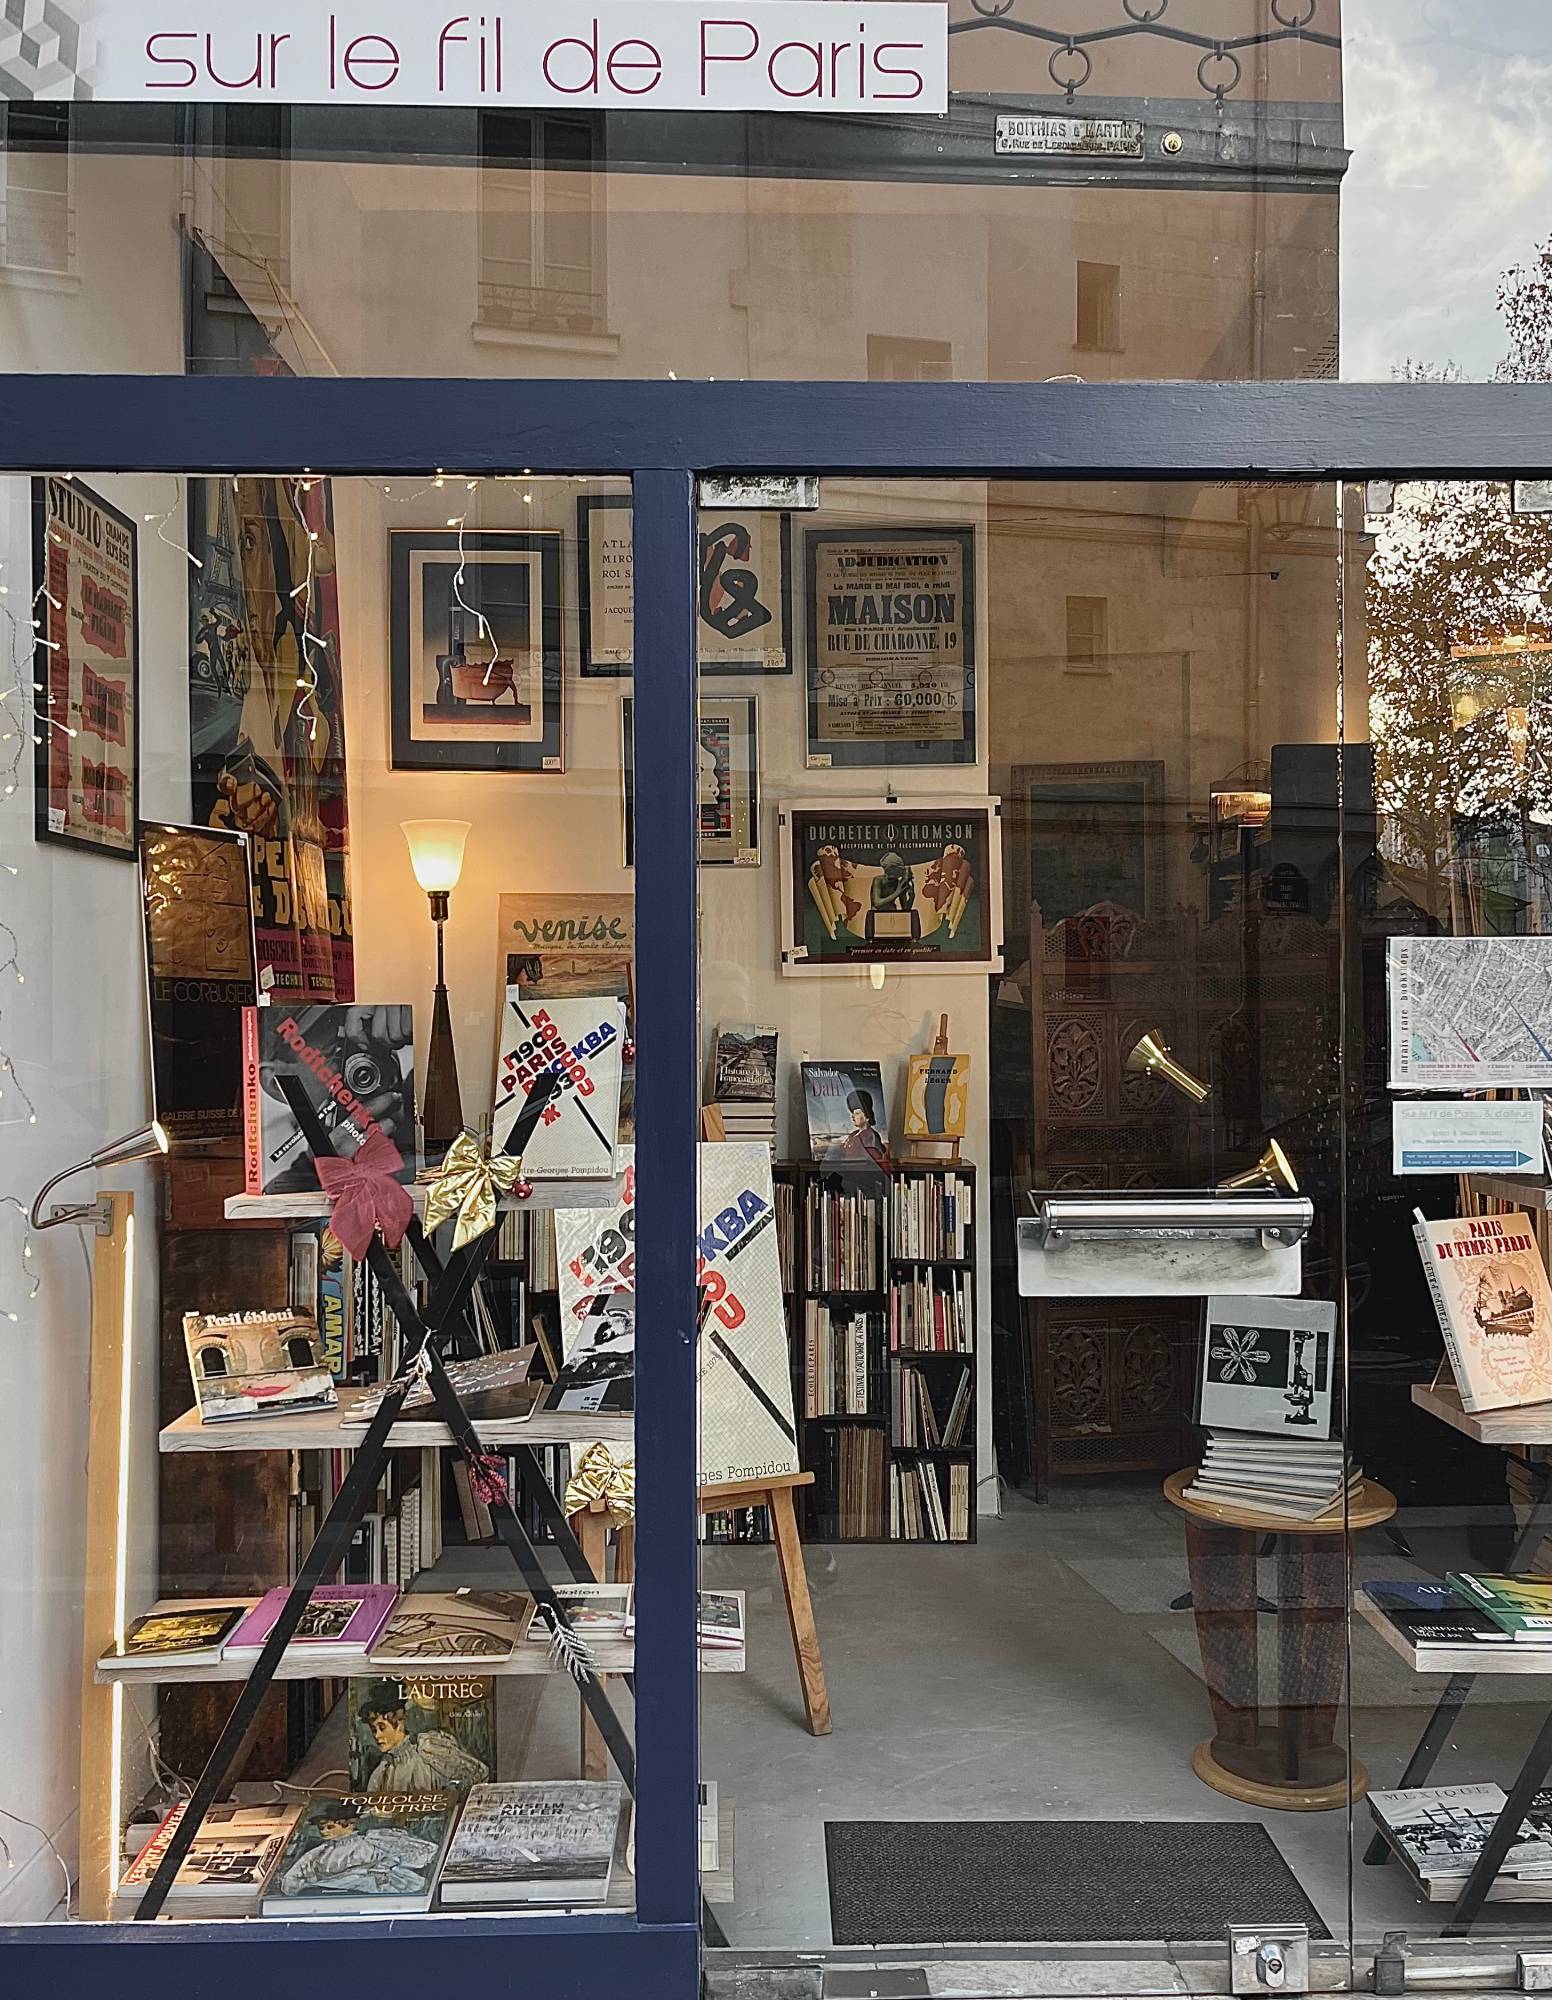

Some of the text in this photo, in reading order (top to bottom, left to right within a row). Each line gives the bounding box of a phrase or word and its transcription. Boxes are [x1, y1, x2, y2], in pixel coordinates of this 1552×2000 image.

[145, 15, 924, 99] sur le fil de Paris
[1008, 121, 1066, 138] BOITHIAS
[1085, 121, 1133, 139] MARTIN
[48, 477, 101, 549] STUDIO
[602, 555, 632, 563] MIRO
[837, 555, 949, 568] ADJUDICATION
[602, 570, 620, 578] ROI
[604, 607, 632, 615] JACQUE
[828, 593, 956, 625] MAISON
[828, 633, 850, 651] RUE
[854, 633, 870, 651] DE
[944, 631, 957, 649] 19
[828, 694, 848, 708] Mise
[864, 693, 882, 706] Prix
[894, 692, 942, 708] 60,000
[809, 823, 973, 841] DUCRETET THOMSON
[513, 914, 628, 942] venise
[153, 981, 255, 1004] LE CORBUSIER
[808, 1067, 840, 1078] Salvador
[161, 1110, 197, 1122] GALERIE
[198, 1109, 226, 1120] SUISSE
[247, 1063, 258, 1183] Rodtchenko
[570, 1165, 609, 1176] Pompidou
[1469, 1220, 1503, 1238] PARIS
[1436, 1234, 1533, 1260] DU TEMPS PERDU
[243, 1308, 295, 1325] ébloui
[324, 1295, 343, 1374] AMAR
[727, 1460, 792, 1482] Pompidou
[397, 1683, 484, 1700] LAUTREC
[339, 1794, 449, 1806] TOULOUSE-
[1383, 1786, 1490, 1801] MEXIQUE
[355, 1803, 448, 1814] LAUTREC
